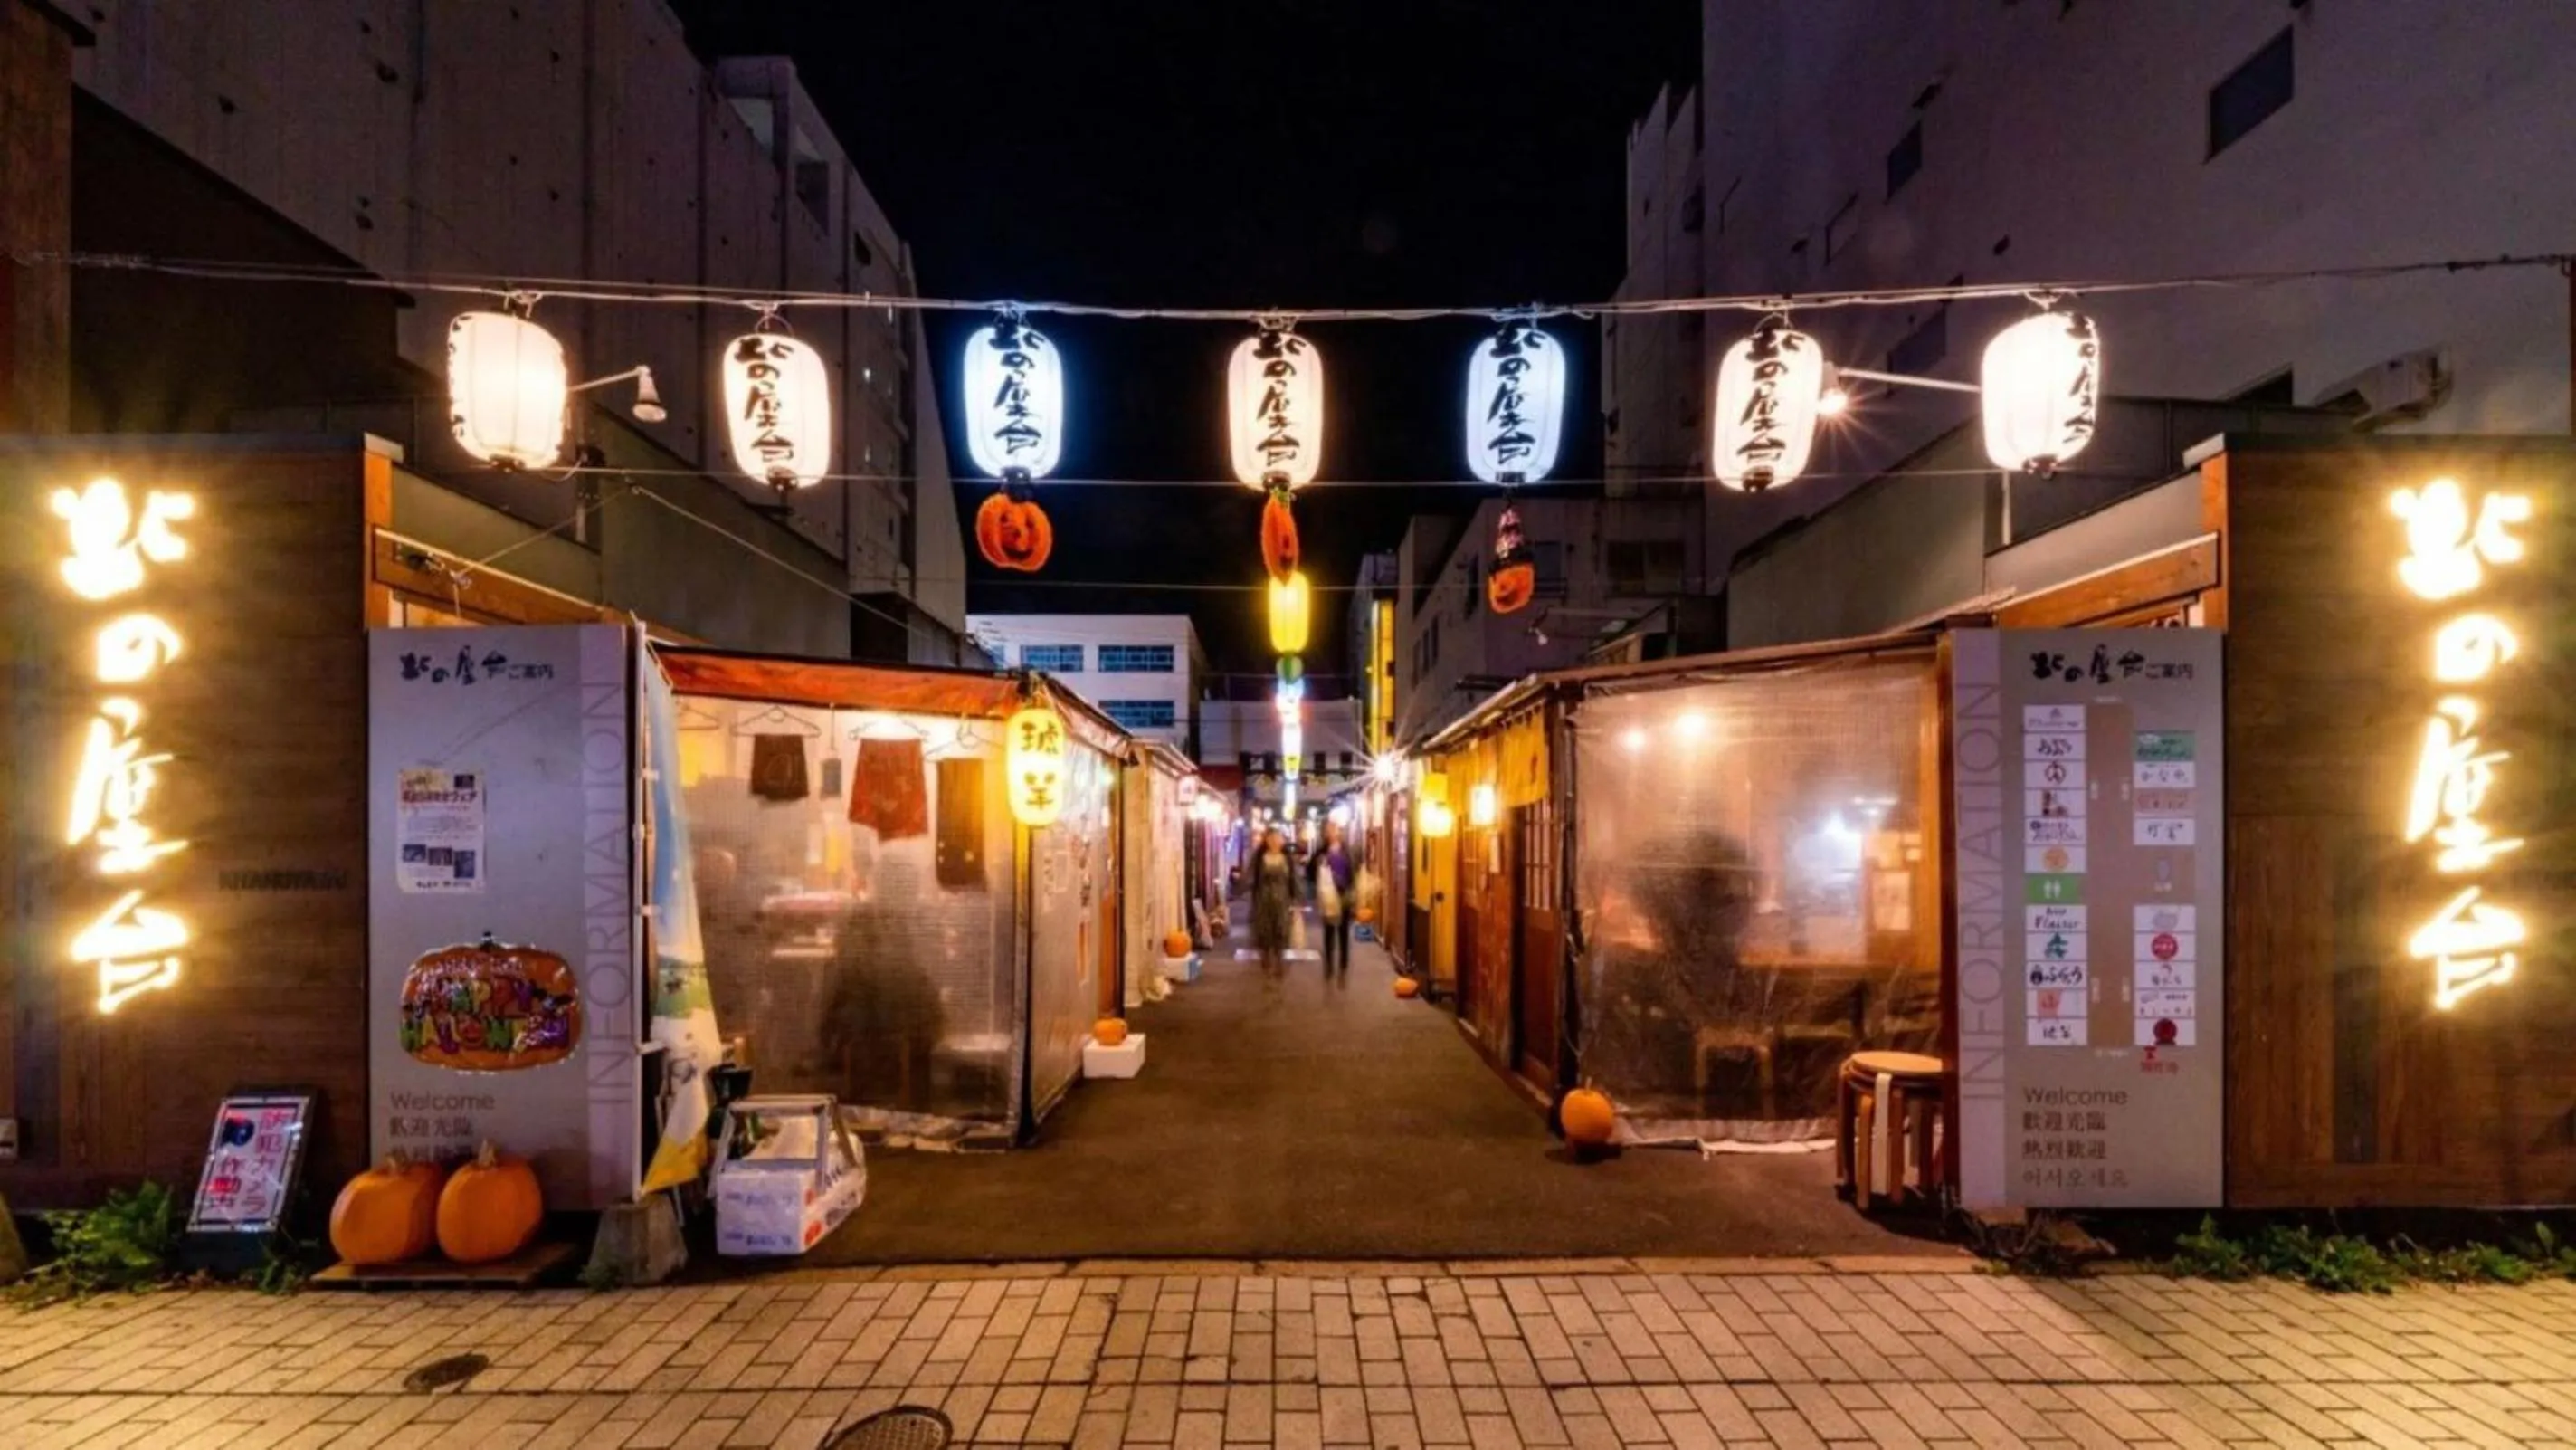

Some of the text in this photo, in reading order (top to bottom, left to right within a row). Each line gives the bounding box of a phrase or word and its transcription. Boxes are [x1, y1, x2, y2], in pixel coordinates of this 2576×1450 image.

[734, 337, 794, 463] 北の屋台
[52, 478, 195, 1014] 北の屋台
[2390, 478, 2531, 1011] 北の屋台
[584, 682, 632, 1103] INFORMATION
[1957, 684, 2003, 1099] INFORMATION
[241, 1110, 292, 1214] 防犯カメラ
[390, 1092, 494, 1110] Welcome
[2022, 1086, 2128, 1105] Welcome
